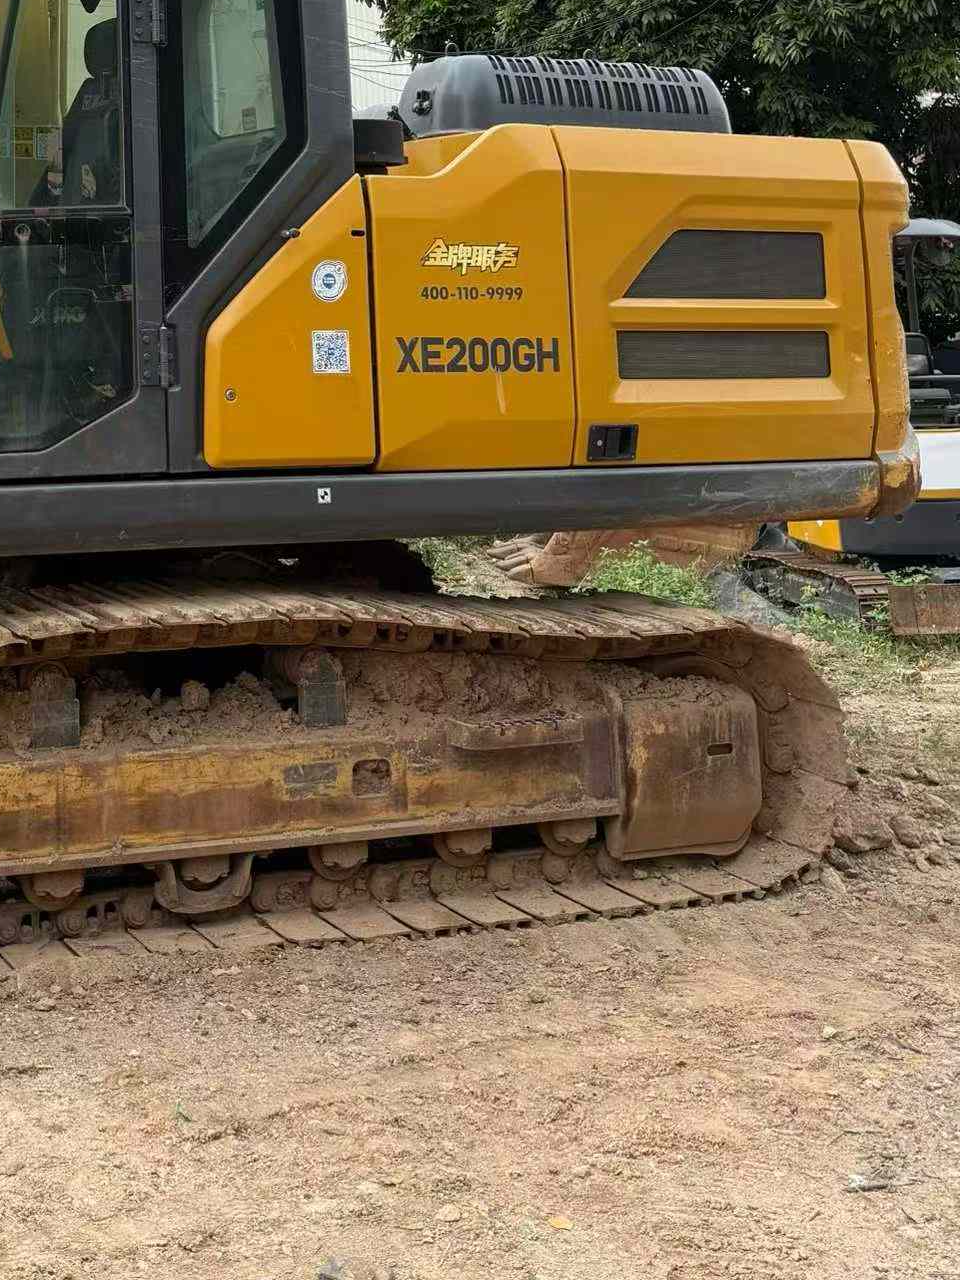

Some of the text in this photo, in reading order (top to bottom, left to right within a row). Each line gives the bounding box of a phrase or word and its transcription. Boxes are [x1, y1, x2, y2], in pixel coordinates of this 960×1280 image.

[422, 238, 520, 275] 金牌服务
[421, 286, 523, 300] 400-110-9999
[396, 336, 560, 373] XE200GH
